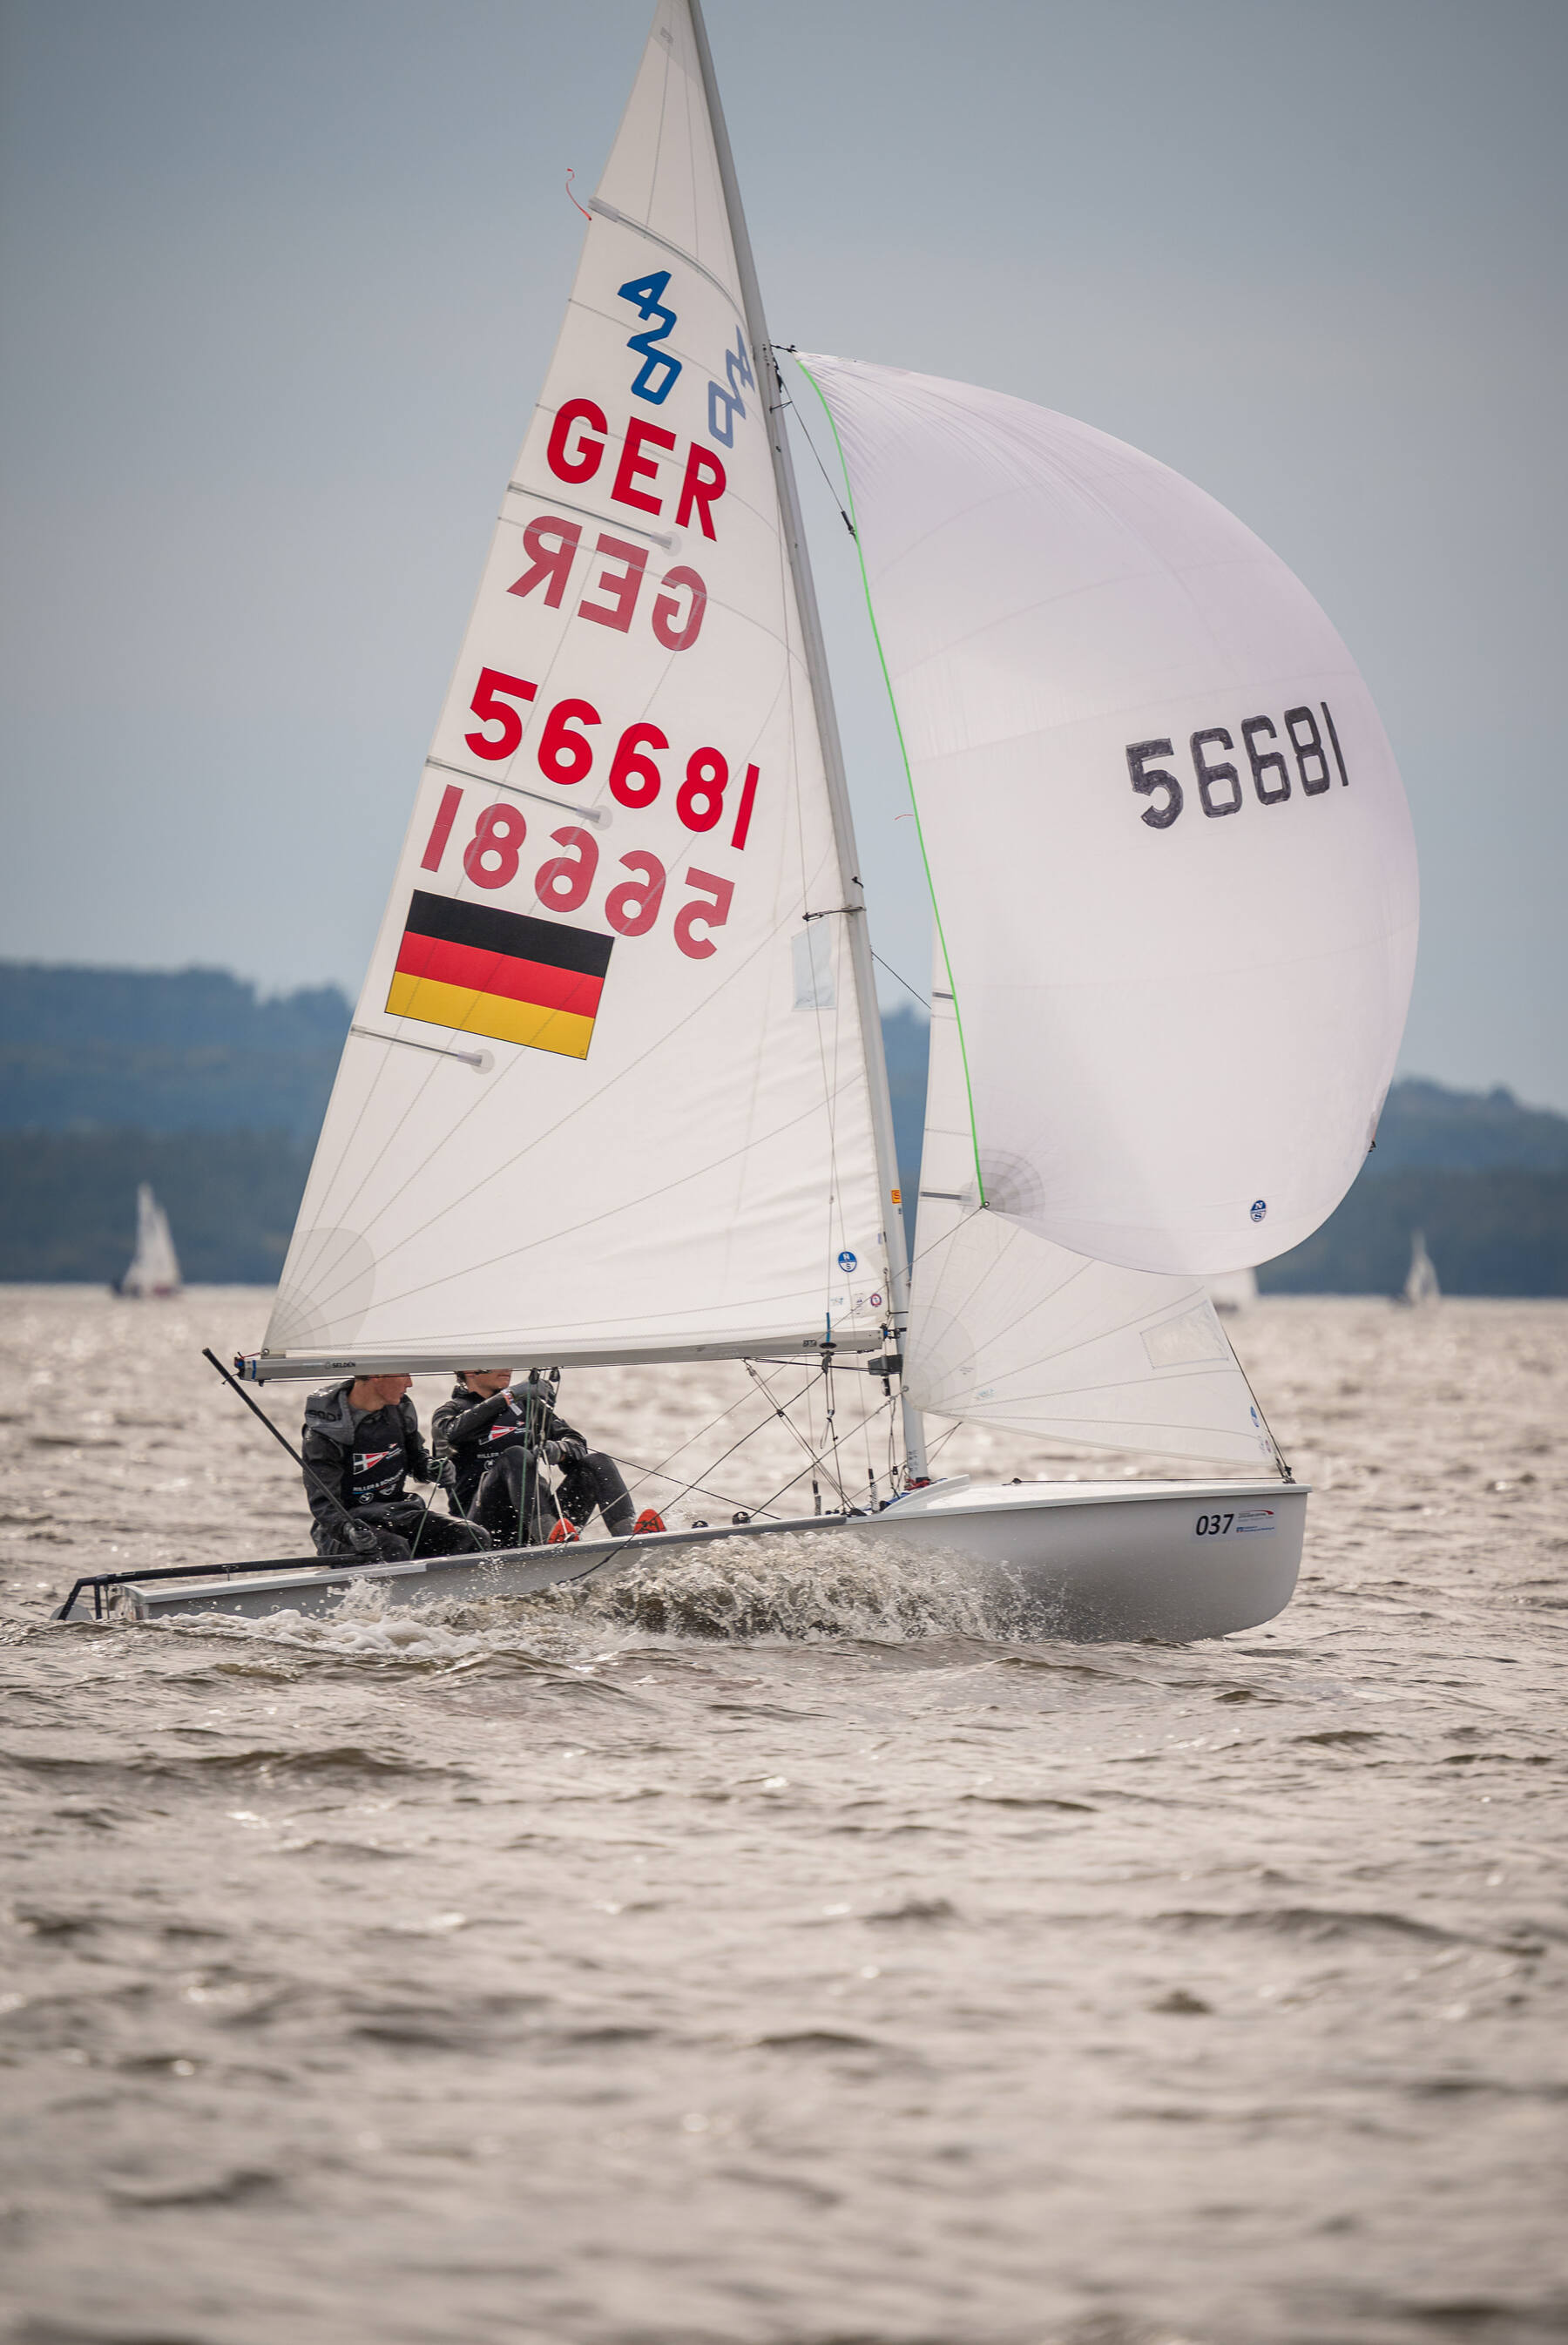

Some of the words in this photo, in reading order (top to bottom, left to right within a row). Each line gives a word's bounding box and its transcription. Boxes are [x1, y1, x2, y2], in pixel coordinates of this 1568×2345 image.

[617, 270, 682, 405] 420
[546, 397, 727, 542] GER
[464, 666, 760, 851] 56681
[1125, 701, 1349, 829] 56681
[1196, 1513, 1234, 1536] 037
